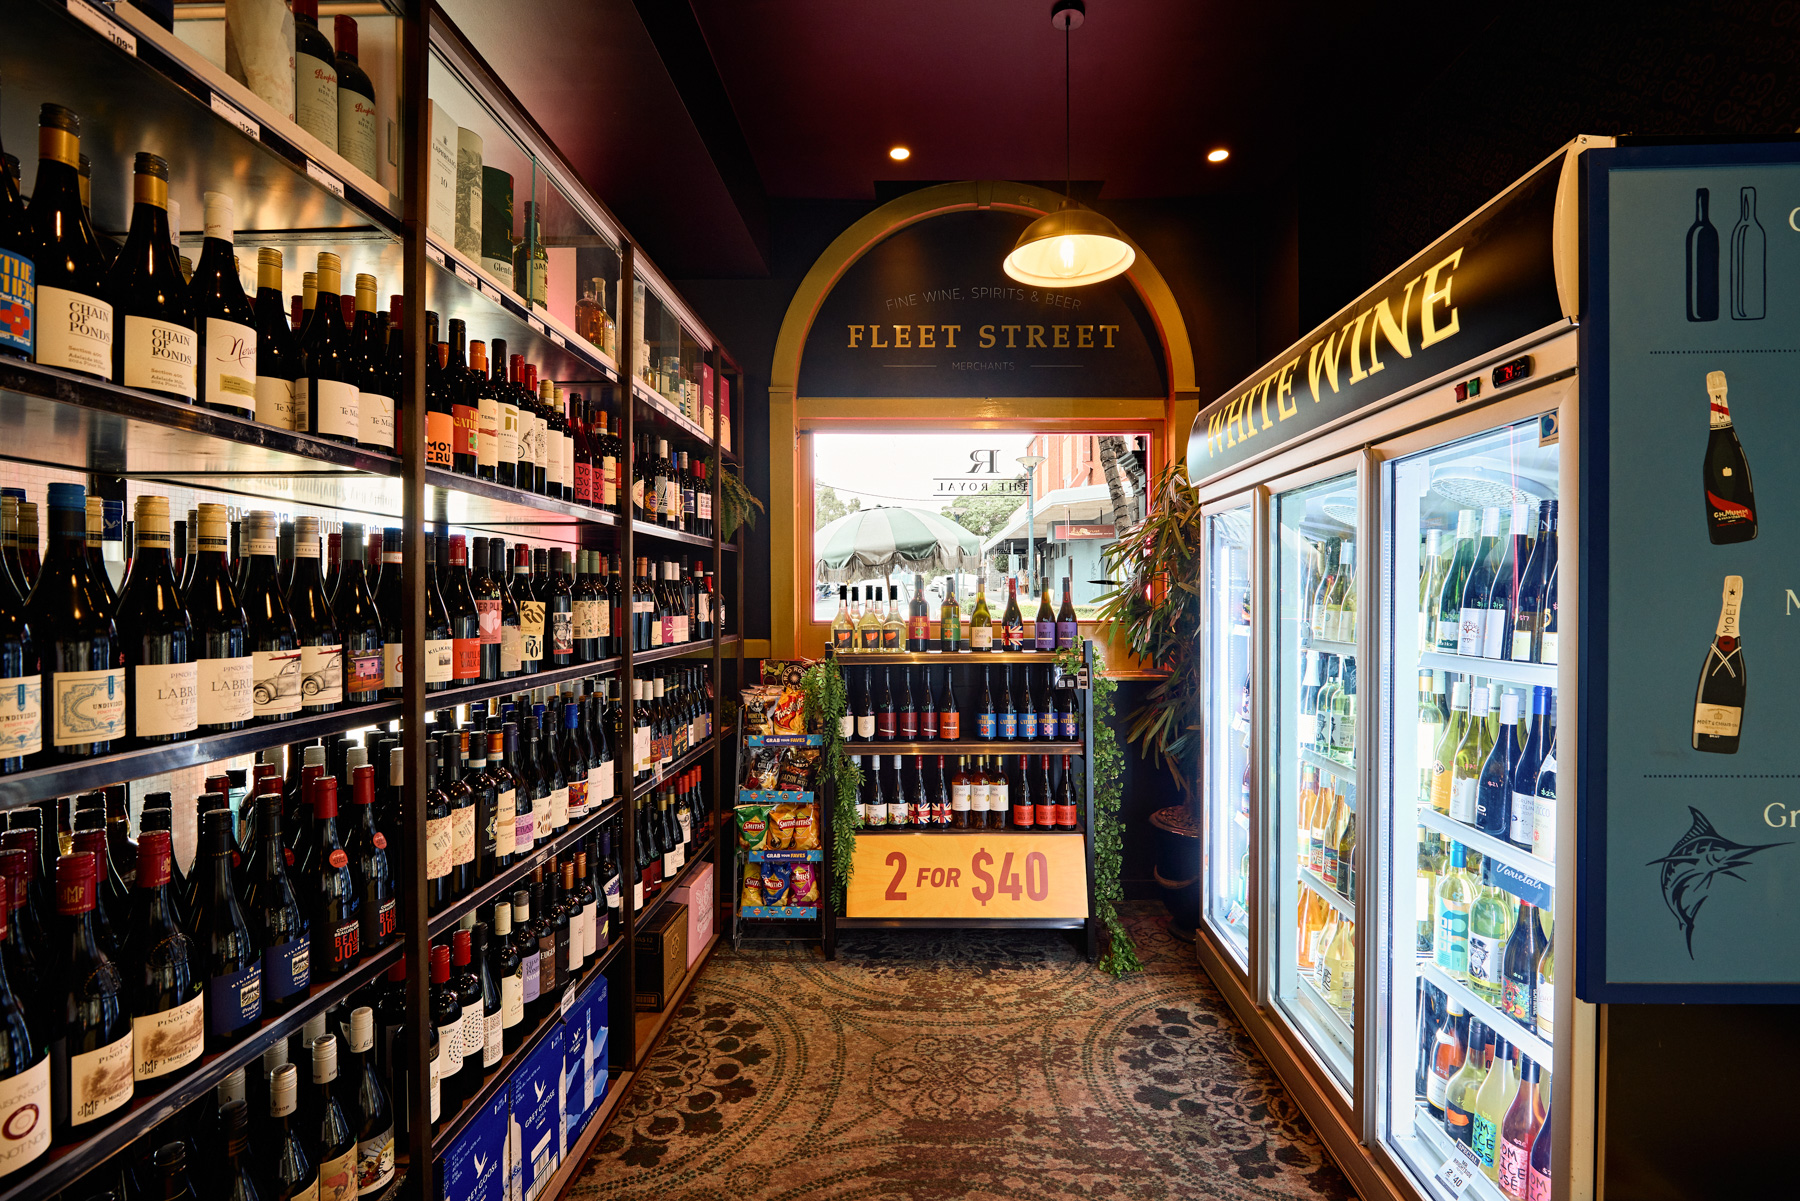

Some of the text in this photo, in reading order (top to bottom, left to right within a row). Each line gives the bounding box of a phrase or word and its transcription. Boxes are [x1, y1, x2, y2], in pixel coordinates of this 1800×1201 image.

[440, 176, 448, 189] 10
[886, 287, 1082, 312] FINE WINE, SPIRITS & BEER
[69, 302, 109, 323] CHAIN
[69, 311, 90, 324] OF
[69, 321, 110, 343] PONDS
[152, 329, 190, 347] CHAIN
[848, 324, 1120, 349] FLEET STREET
[68, 345, 92, 356] Section
[152, 338, 171, 349] OF
[68, 352, 93, 363] Adelaide
[152, 346, 192, 365] PONDS
[1208, 247, 1464, 458] WHITE WINE
[151, 368, 173, 377] Section
[952, 361, 1015, 371] MERCHANTS
[151, 375, 174, 383] Adelaide
[274, 402, 285, 412] Te
[340, 406, 351, 416] Te
[371, 416, 382, 425] Te
[744, 822, 765, 831] SMITH'S
[885, 848, 1049, 906] 2 FOR $40
[1496, 862, 1544, 890] Varietals
[335, 928, 358, 948] BEAU
[158, 1014, 183, 1028] PINOT
[98, 1048, 124, 1065] PINOT
[525, 1109, 538, 1128] GREY
[538, 1088, 555, 1112] GOOSE
[1456, 1143, 1481, 1166] SPECIAL
[479, 1160, 498, 1189] GOOSE
